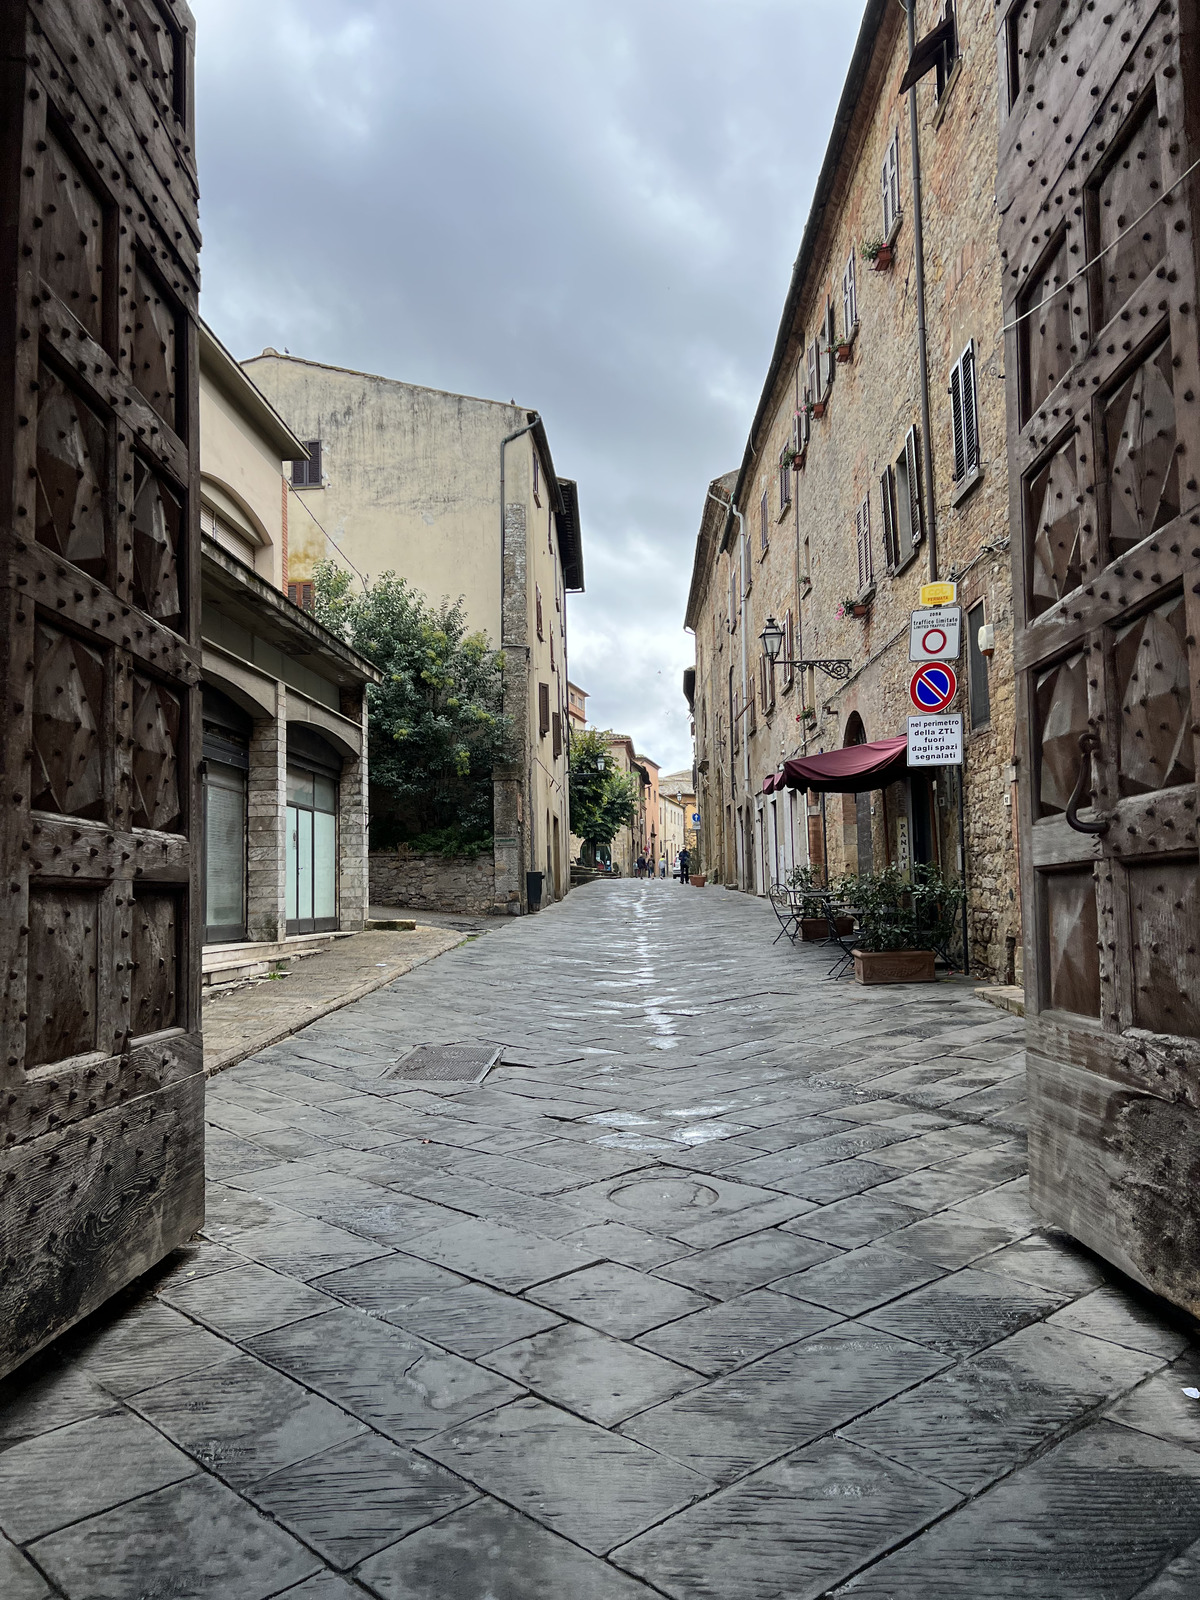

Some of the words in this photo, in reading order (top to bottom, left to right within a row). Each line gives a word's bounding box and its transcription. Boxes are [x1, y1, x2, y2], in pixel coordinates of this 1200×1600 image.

[924, 720, 959, 728] perimetro
[912, 744, 933, 752] dagli
[935, 743, 957, 751] spazi
[915, 752, 955, 760] segnalati
